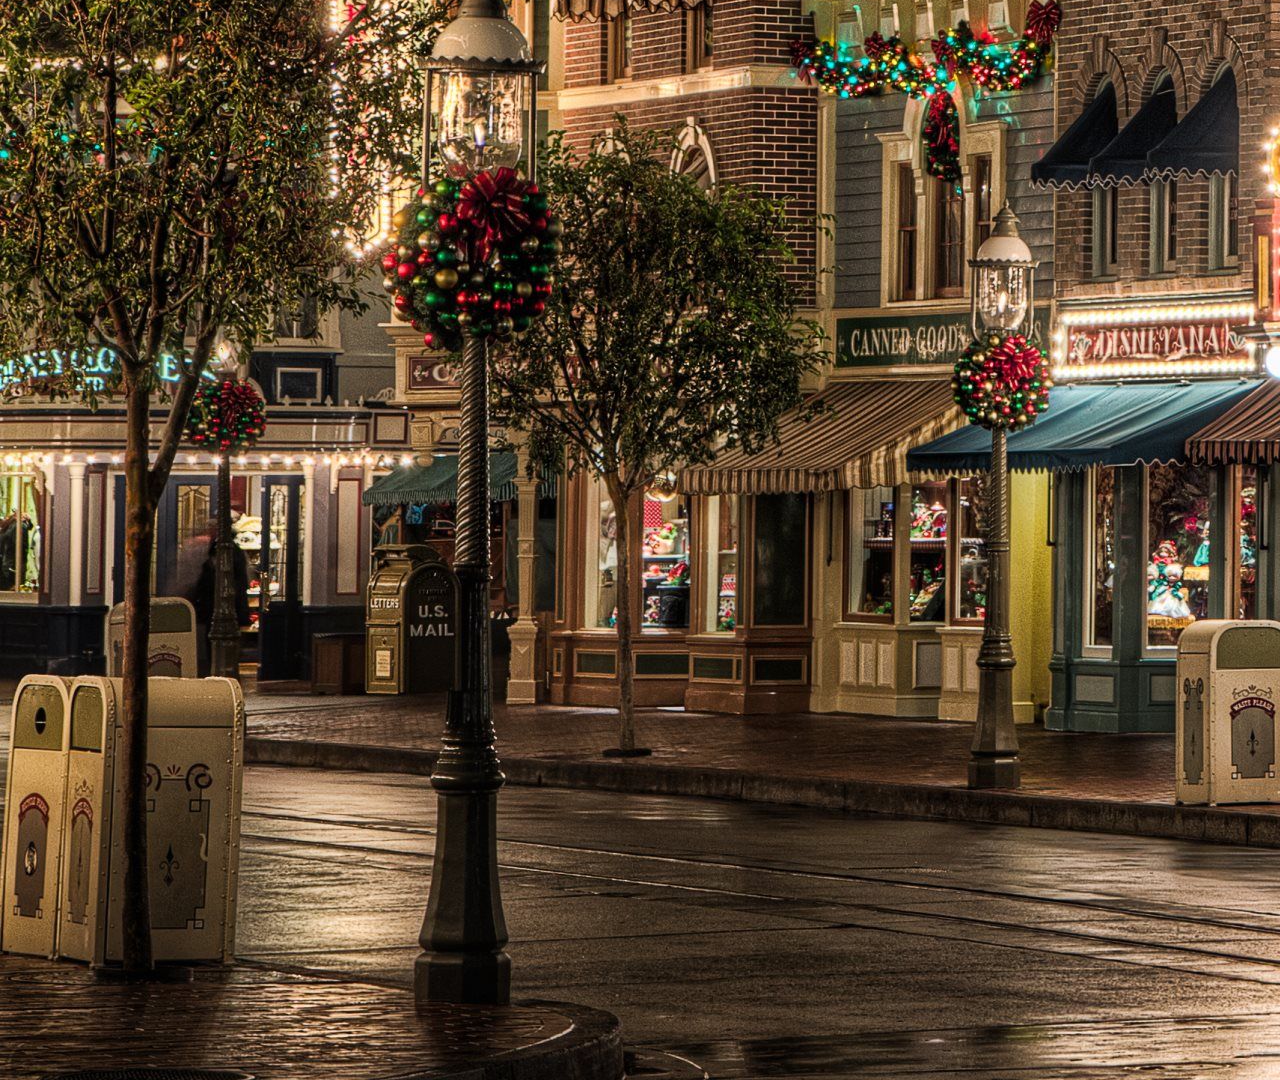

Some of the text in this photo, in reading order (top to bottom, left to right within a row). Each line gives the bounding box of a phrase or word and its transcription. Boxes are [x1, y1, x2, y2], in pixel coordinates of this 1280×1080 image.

[850, 324, 967, 357] CANNED GOODS
[1093, 323, 1222, 362] DISNEYANA
[370, 598, 399, 609] LETTERS
[418, 605, 449, 618] U.S.
[410, 623, 455, 638] MAIL
[1233, 699, 1251, 711] WASTE
